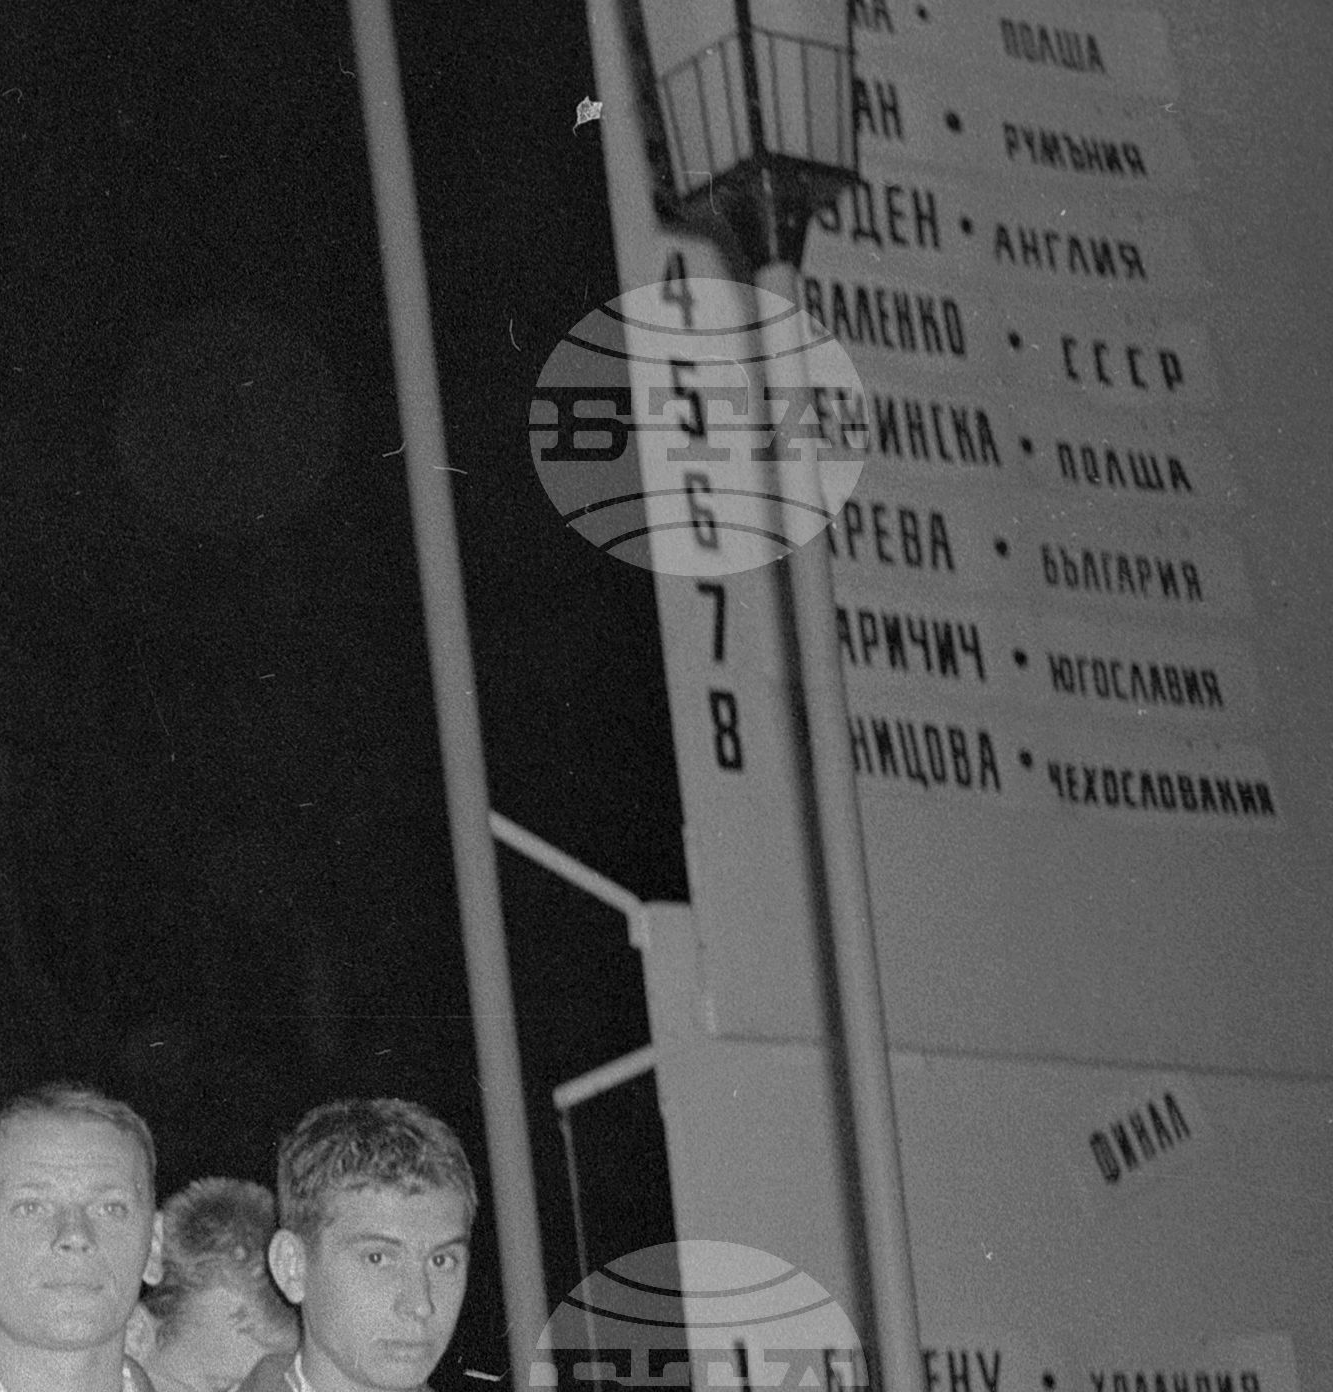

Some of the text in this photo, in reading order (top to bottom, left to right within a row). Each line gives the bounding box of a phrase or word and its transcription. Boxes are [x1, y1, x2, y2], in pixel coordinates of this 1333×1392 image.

[1000, 17, 1107, 75] ПОЛША
[1003, 121, 1147, 176] РУМЪНИЯ
[995, 222, 1148, 281] АНГЛИЯ
[662, 252, 694, 328] 4
[1061, 333, 1184, 391] СССР
[670, 360, 705, 436] 5
[1058, 440, 1193, 494] ПОЛША
[685, 472, 719, 550] 6
[1041, 541, 1204, 602] БЪЛГАРИЯ
[697, 582, 726, 661] 7
[1047, 650, 1226, 709] ЮГОСЛАВИЯ
[709, 691, 744, 772] 8
